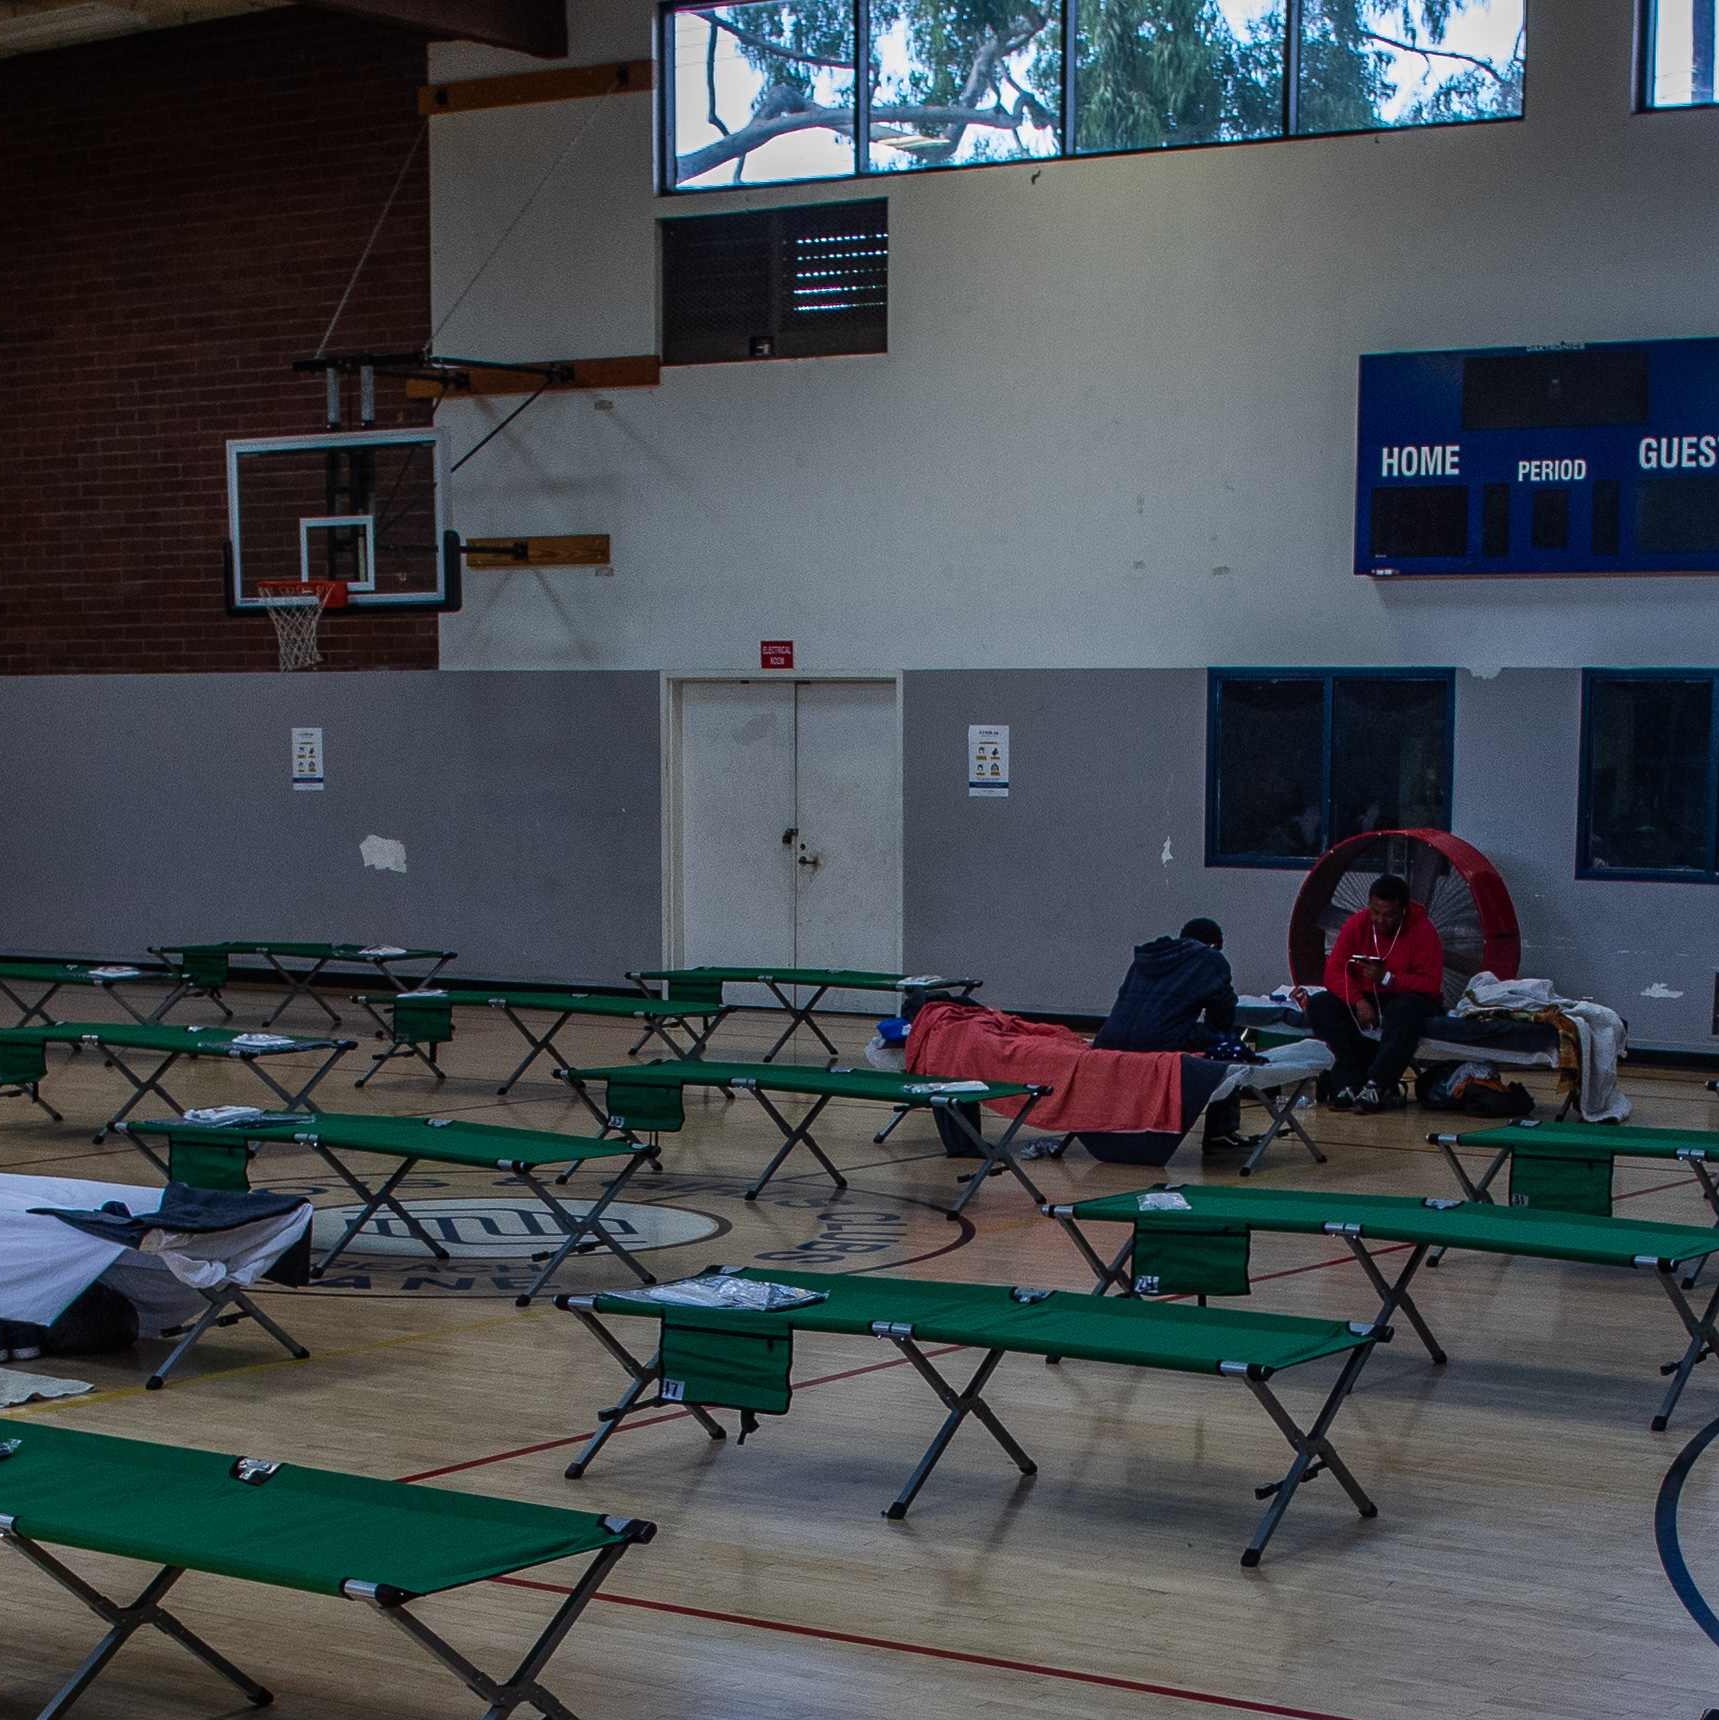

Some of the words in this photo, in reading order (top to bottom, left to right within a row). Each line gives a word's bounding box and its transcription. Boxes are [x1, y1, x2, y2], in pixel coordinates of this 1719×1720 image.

[1381, 445, 1461, 477] HOME
[1517, 459, 1587, 483] PERIOD
[753, 1211, 908, 1264] CLUBS
[665, 1380, 679, 1397] 17
